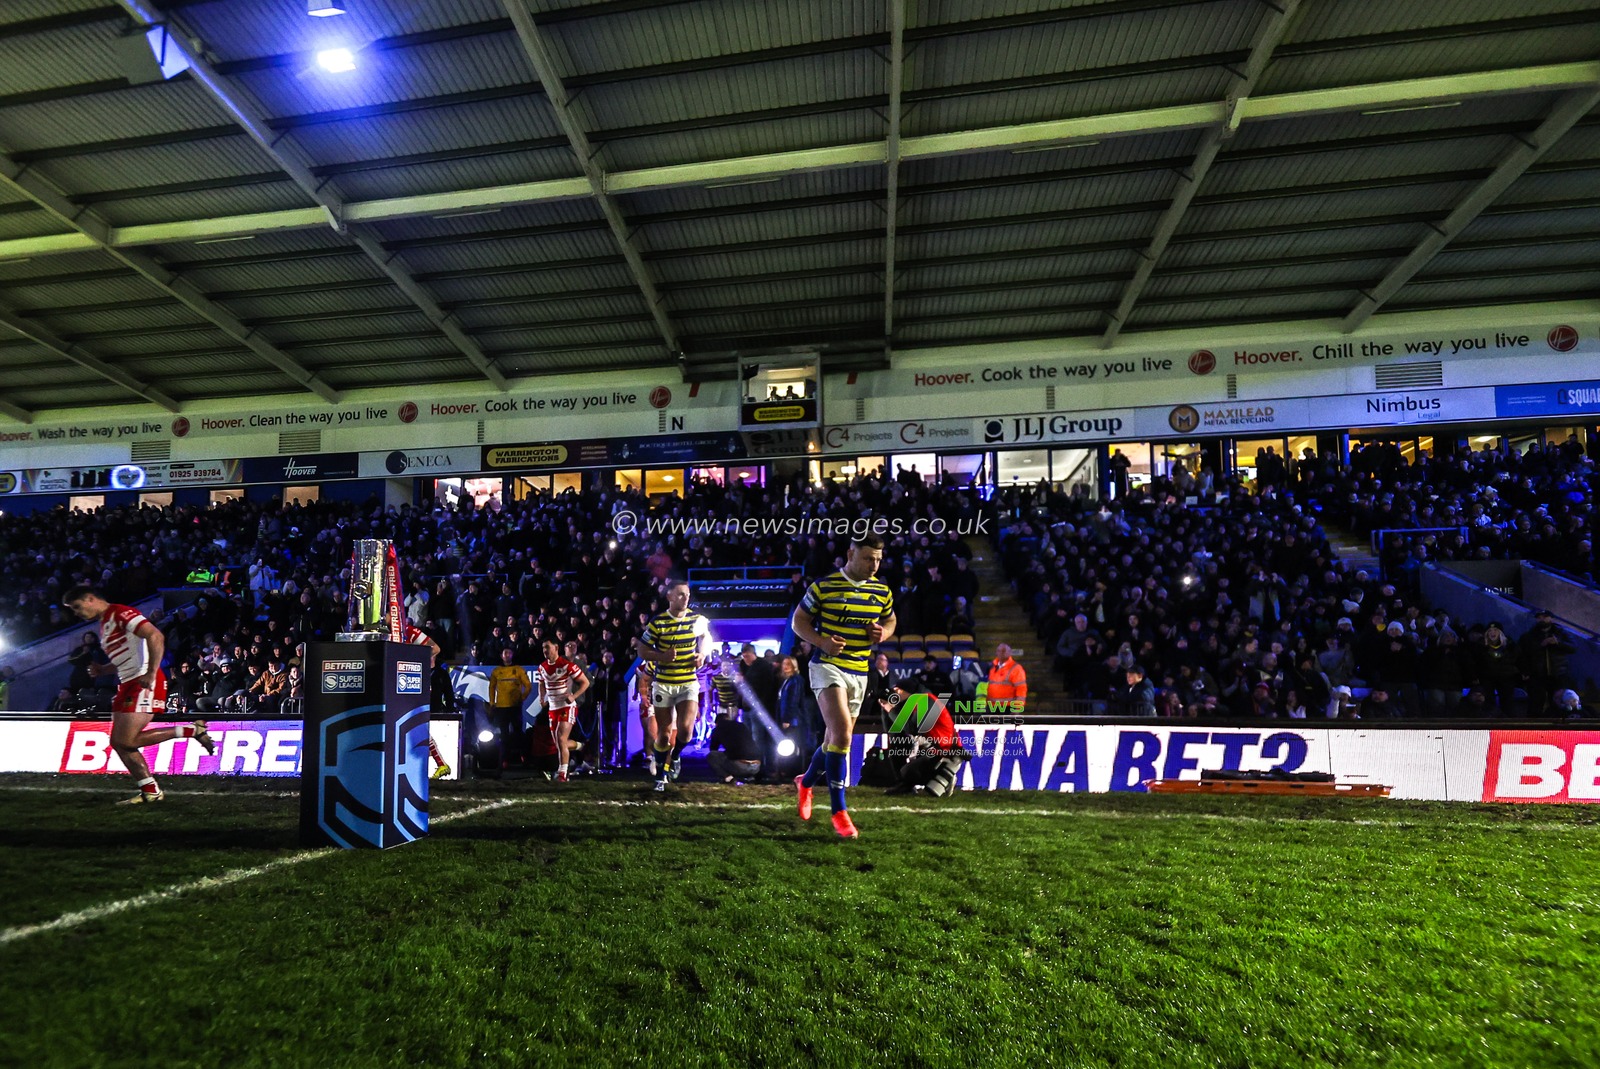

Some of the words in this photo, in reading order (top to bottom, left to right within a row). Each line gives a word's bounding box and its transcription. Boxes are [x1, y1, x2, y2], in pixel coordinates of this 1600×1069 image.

[1234, 348, 1303, 366] Hoover.
[1312, 343, 1354, 360] Chill
[1361, 341, 1394, 356] the
[1404, 338, 1443, 355] way
[1450, 336, 1487, 355] you
[1495, 333, 1530, 348] live
[914, 372, 975, 386] Hoover.
[981, 366, 1023, 382] Cook
[1029, 363, 1057, 379] the
[1063, 363, 1097, 379] way
[1104, 360, 1135, 377] you
[1142, 356, 1173, 371] live
[430, 402, 479, 416] Hoover.
[484, 399, 518, 413] Cook
[523, 397, 546, 410] the
[550, 395, 578, 409] way
[582, 393, 607, 407] you
[612, 391, 637, 405] live
[1366, 396, 1441, 414] Nimbus
[201, 416, 246, 430] Hoover.
[249, 413, 282, 427] Clean
[286, 411, 306, 424] the
[308, 411, 334, 425] way
[338, 410, 361, 424] you
[366, 407, 388, 420] live
[1203, 406, 1274, 420] MAXILEAD
[1417, 410, 1441, 419] Legal
[671, 415, 684, 431] N
[1012, 417, 1044, 441] JLJ
[1049, 415, 1123, 436] Group
[1204, 419, 1228, 427] METAL
[1230, 416, 1275, 425] RECYCLING
[0, 431, 33, 442] oover.
[37, 427, 66, 440] Wash
[69, 426, 88, 438] the
[92, 426, 114, 438] way
[117, 424, 137, 437] you
[142, 421, 162, 435] live
[853, 430, 893, 443] Projects
[928, 425, 969, 439] Projects
[494, 447, 560, 458] WARRINGTON
[494, 454, 561, 464] FABRICATIONS
[399, 453, 453, 469] SENECA
[169, 470, 192, 479] 01925
[388, 565, 398, 603] BETFRED
[390, 605, 401, 643] BETFRED
[324, 662, 363, 670] BETFRED
[398, 663, 421, 672] BETFRED
[338, 675, 363, 683] SUPER
[406, 676, 421, 684] SUPER
